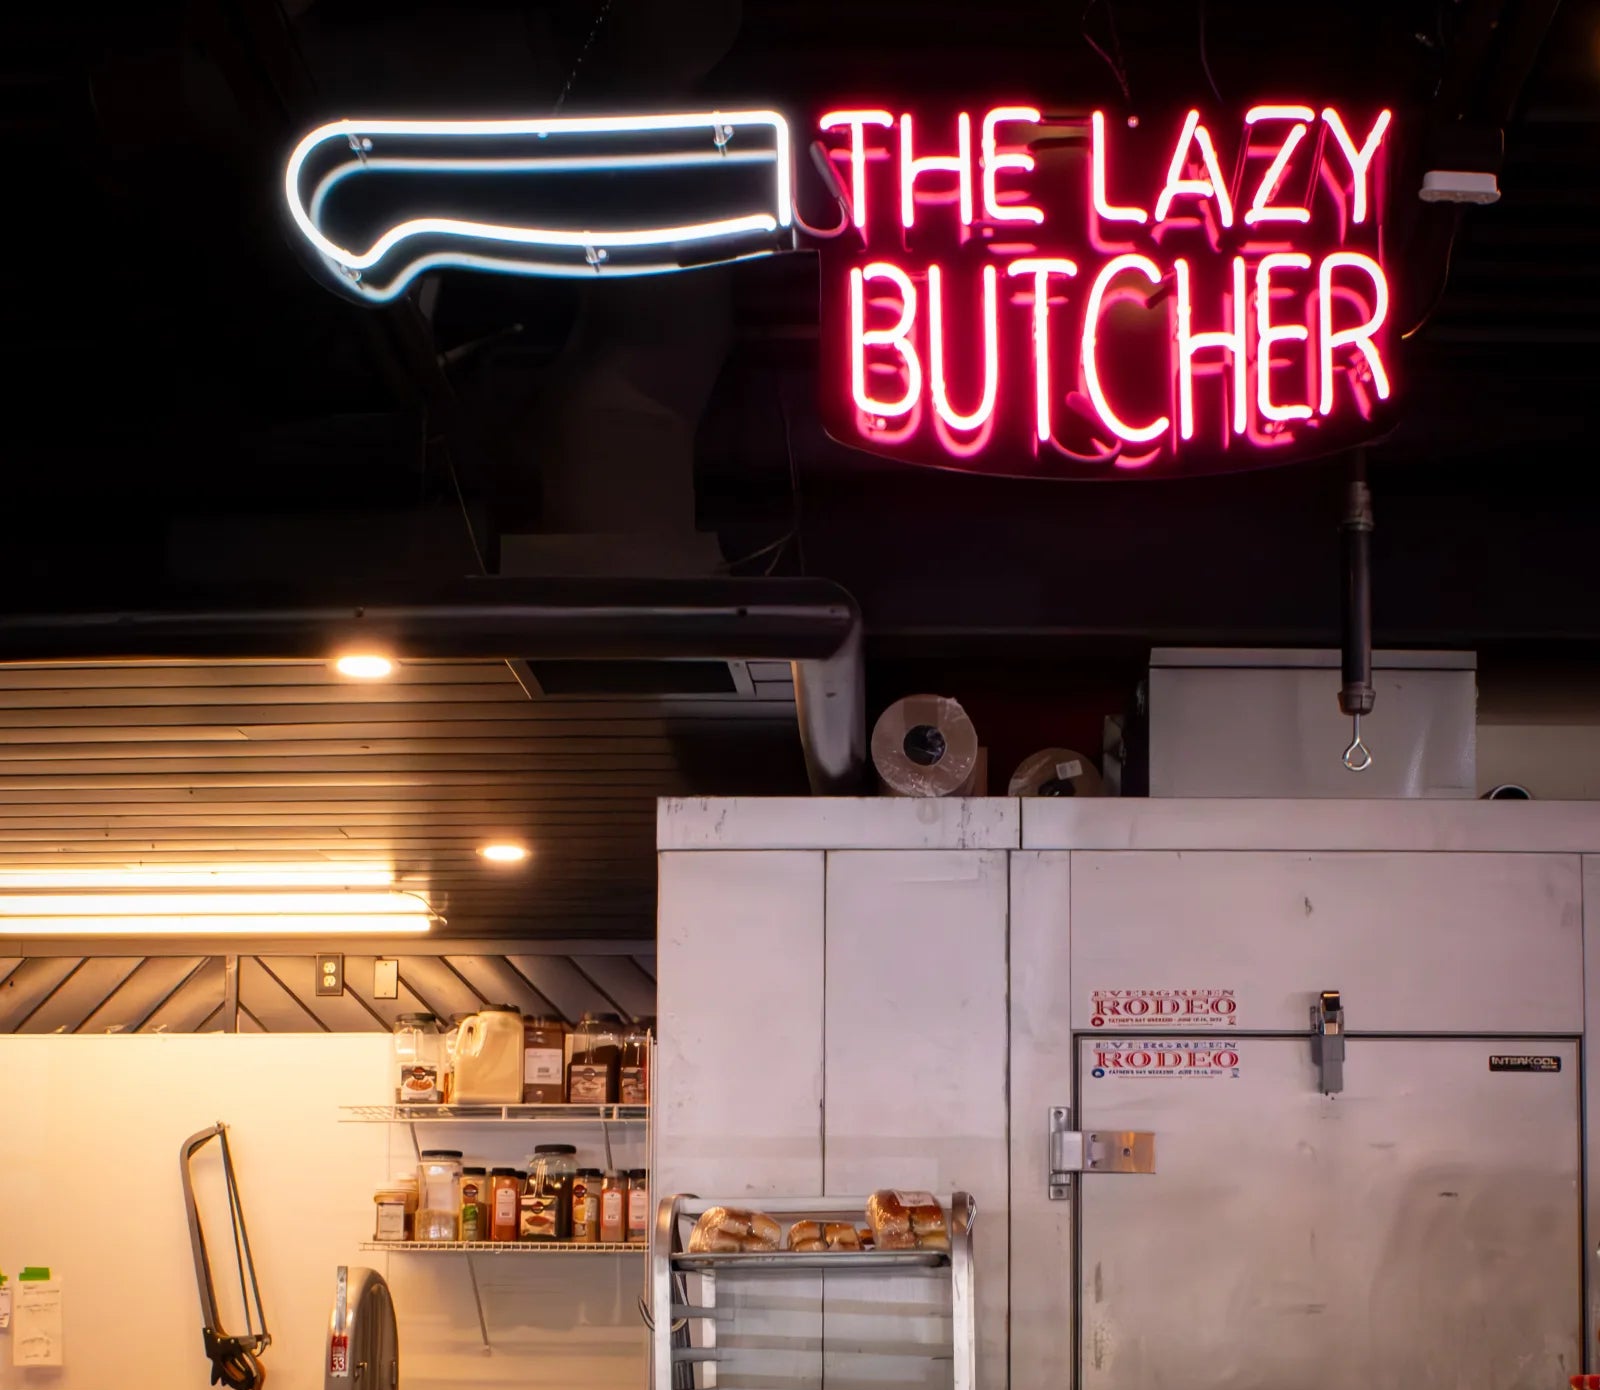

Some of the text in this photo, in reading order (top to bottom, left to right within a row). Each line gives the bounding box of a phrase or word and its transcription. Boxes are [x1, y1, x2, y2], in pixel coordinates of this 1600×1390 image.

[819, 105, 1393, 229] THE LAZY
[850, 251, 1391, 444] BUTCHER
[1092, 998, 1237, 1016] RODEO
[1094, 1050, 1239, 1068] RODEO
[1491, 1056, 1558, 1065] INTERKOOL
